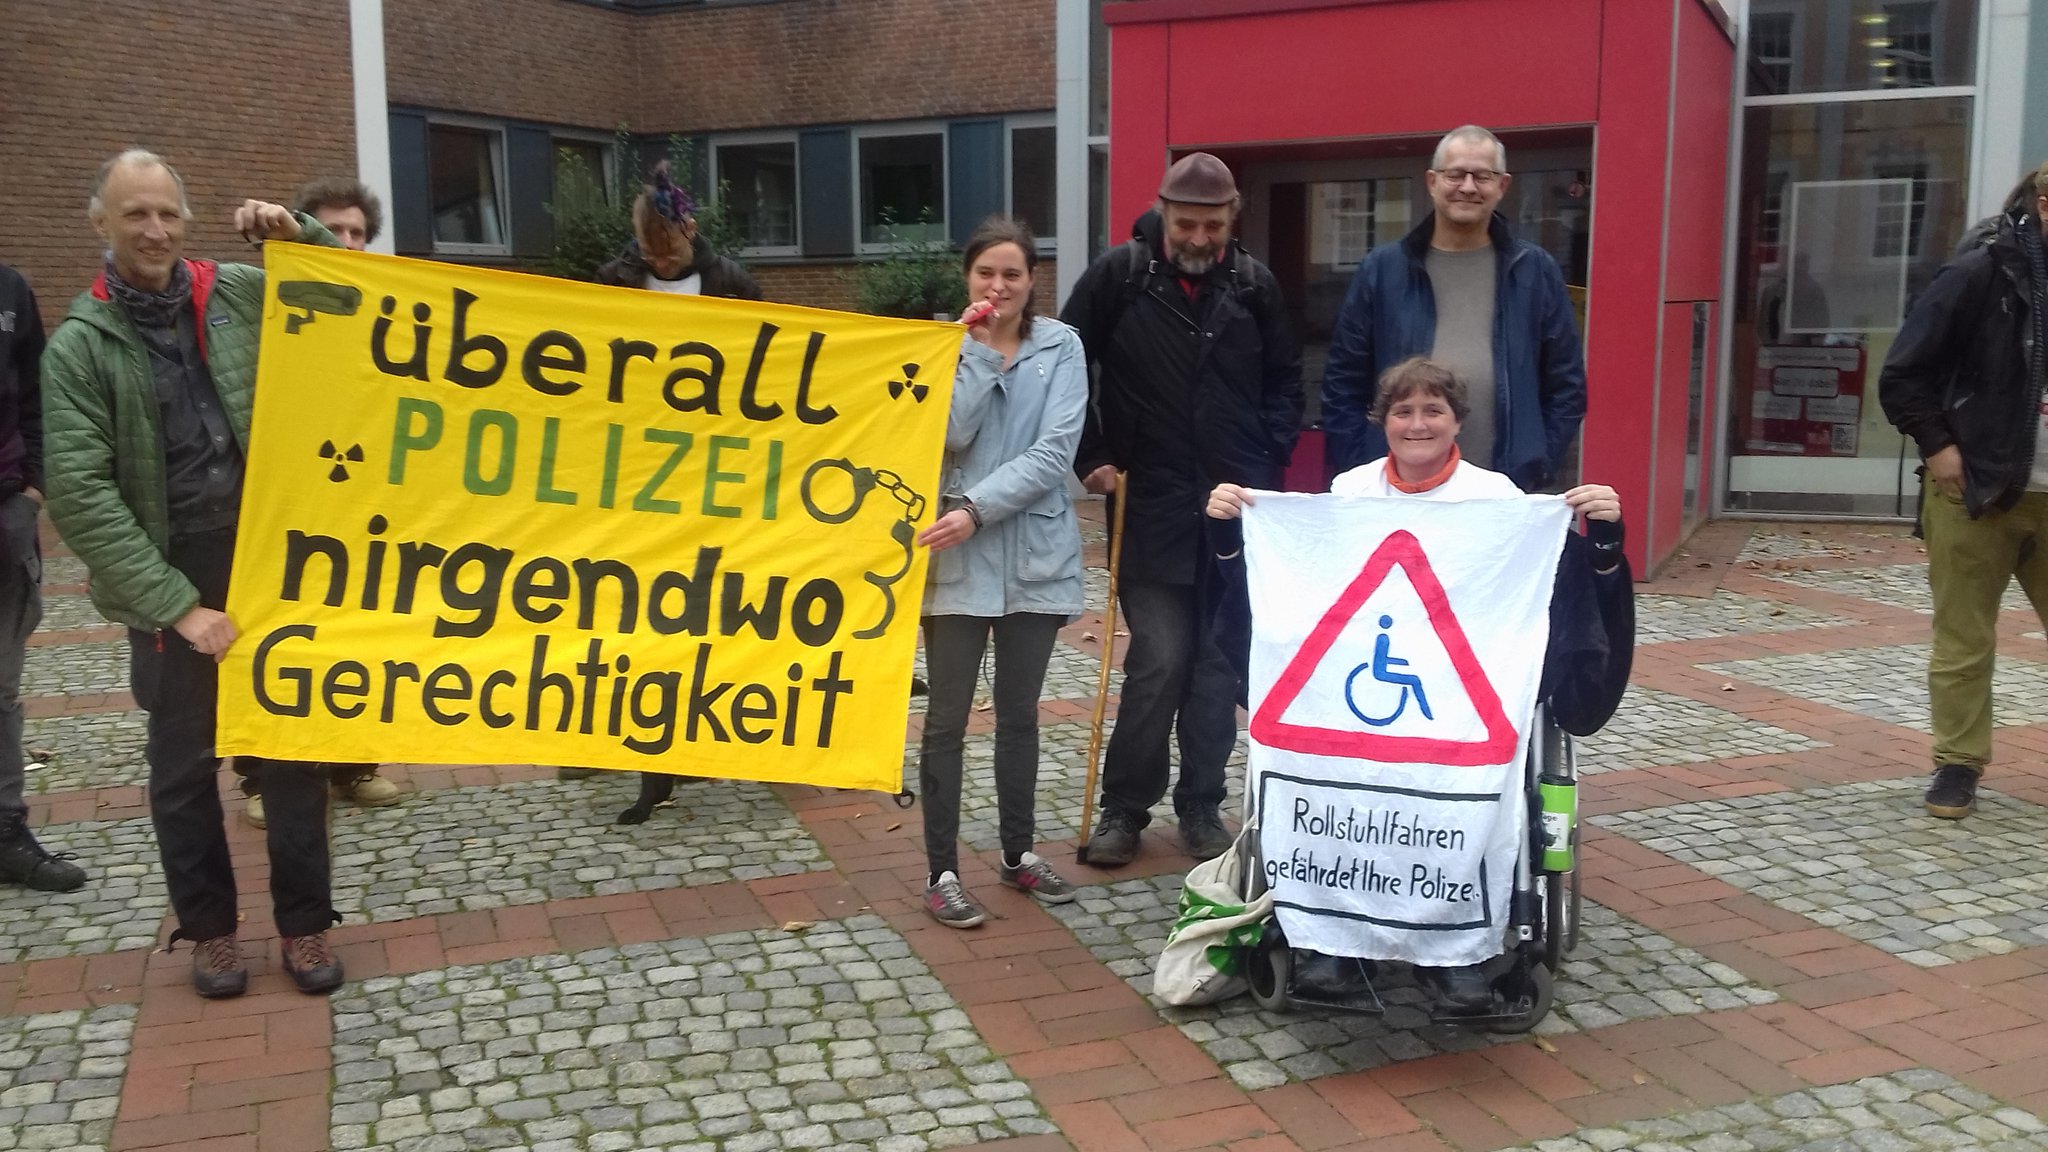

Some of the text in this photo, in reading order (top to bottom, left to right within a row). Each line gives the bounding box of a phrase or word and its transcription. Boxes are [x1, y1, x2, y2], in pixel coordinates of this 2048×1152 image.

[370, 287, 839, 425] überall
[388, 396, 784, 521] POLIZEI
[280, 514, 844, 647] nirgendwo
[252, 624, 854, 755] Gerechtigkeit
[1293, 797, 1465, 851] Rollstuhlfahren
